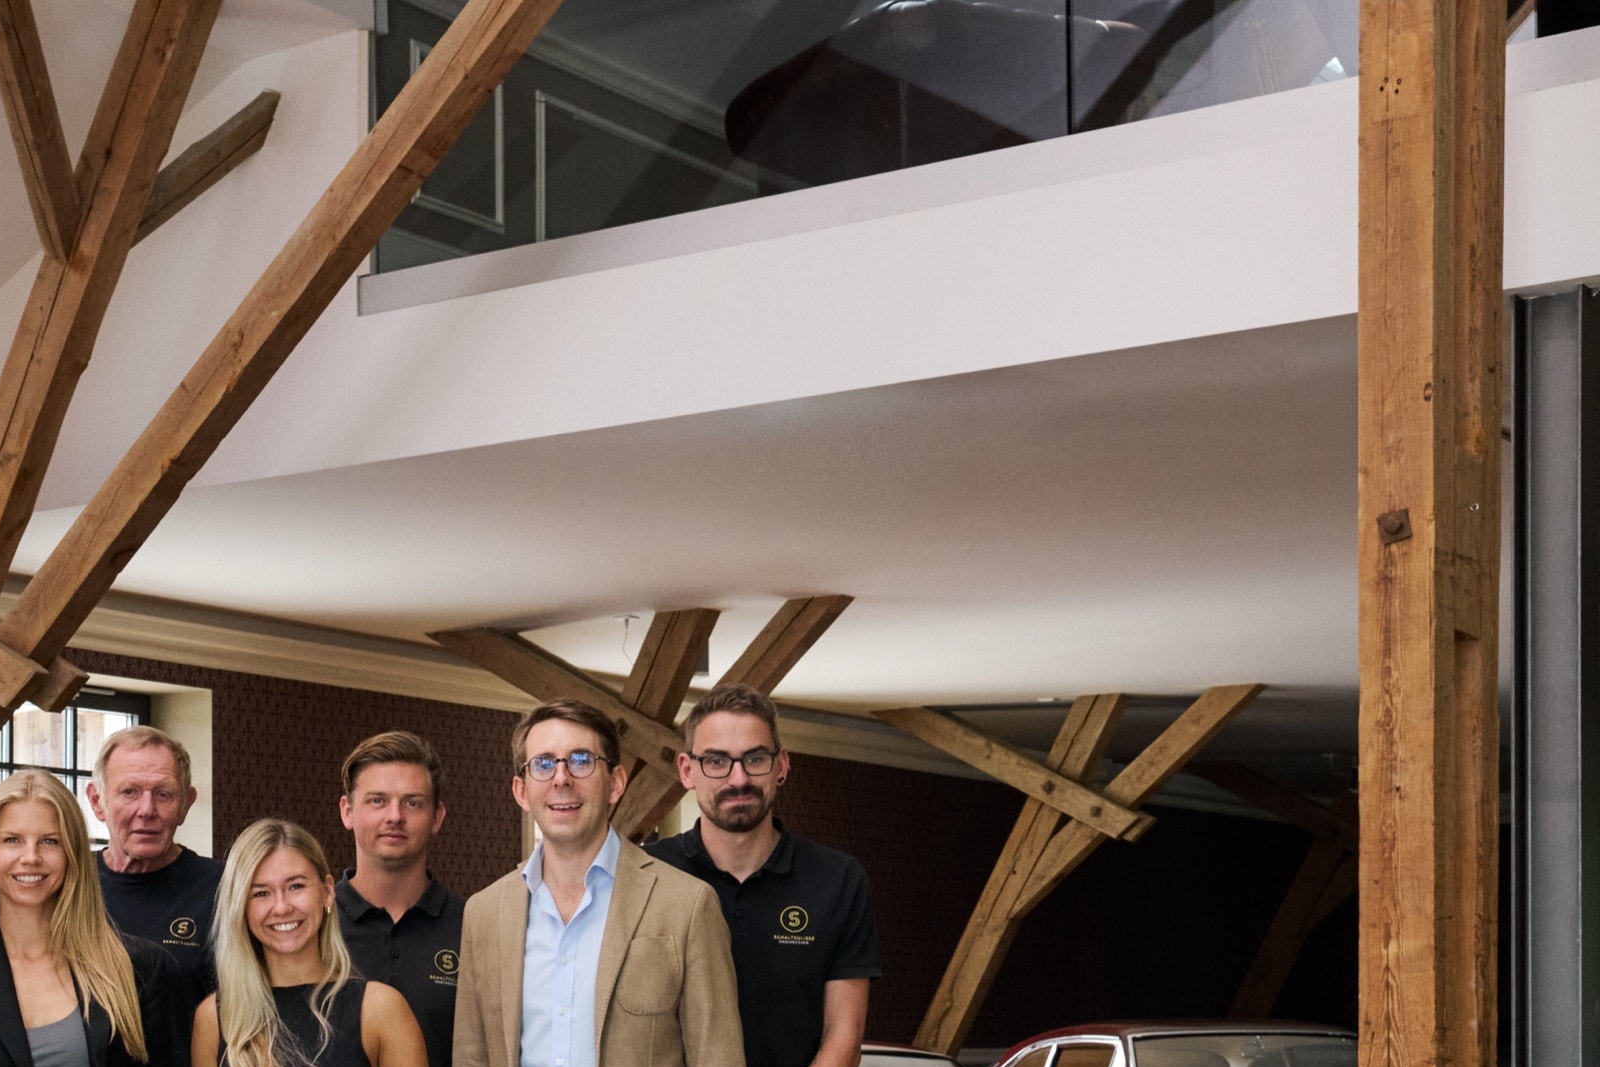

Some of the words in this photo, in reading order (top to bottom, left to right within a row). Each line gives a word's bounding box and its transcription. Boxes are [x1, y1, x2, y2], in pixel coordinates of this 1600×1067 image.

[788, 911, 800, 927] S
[178, 921, 188, 934] S
[442, 954, 453, 969] S
